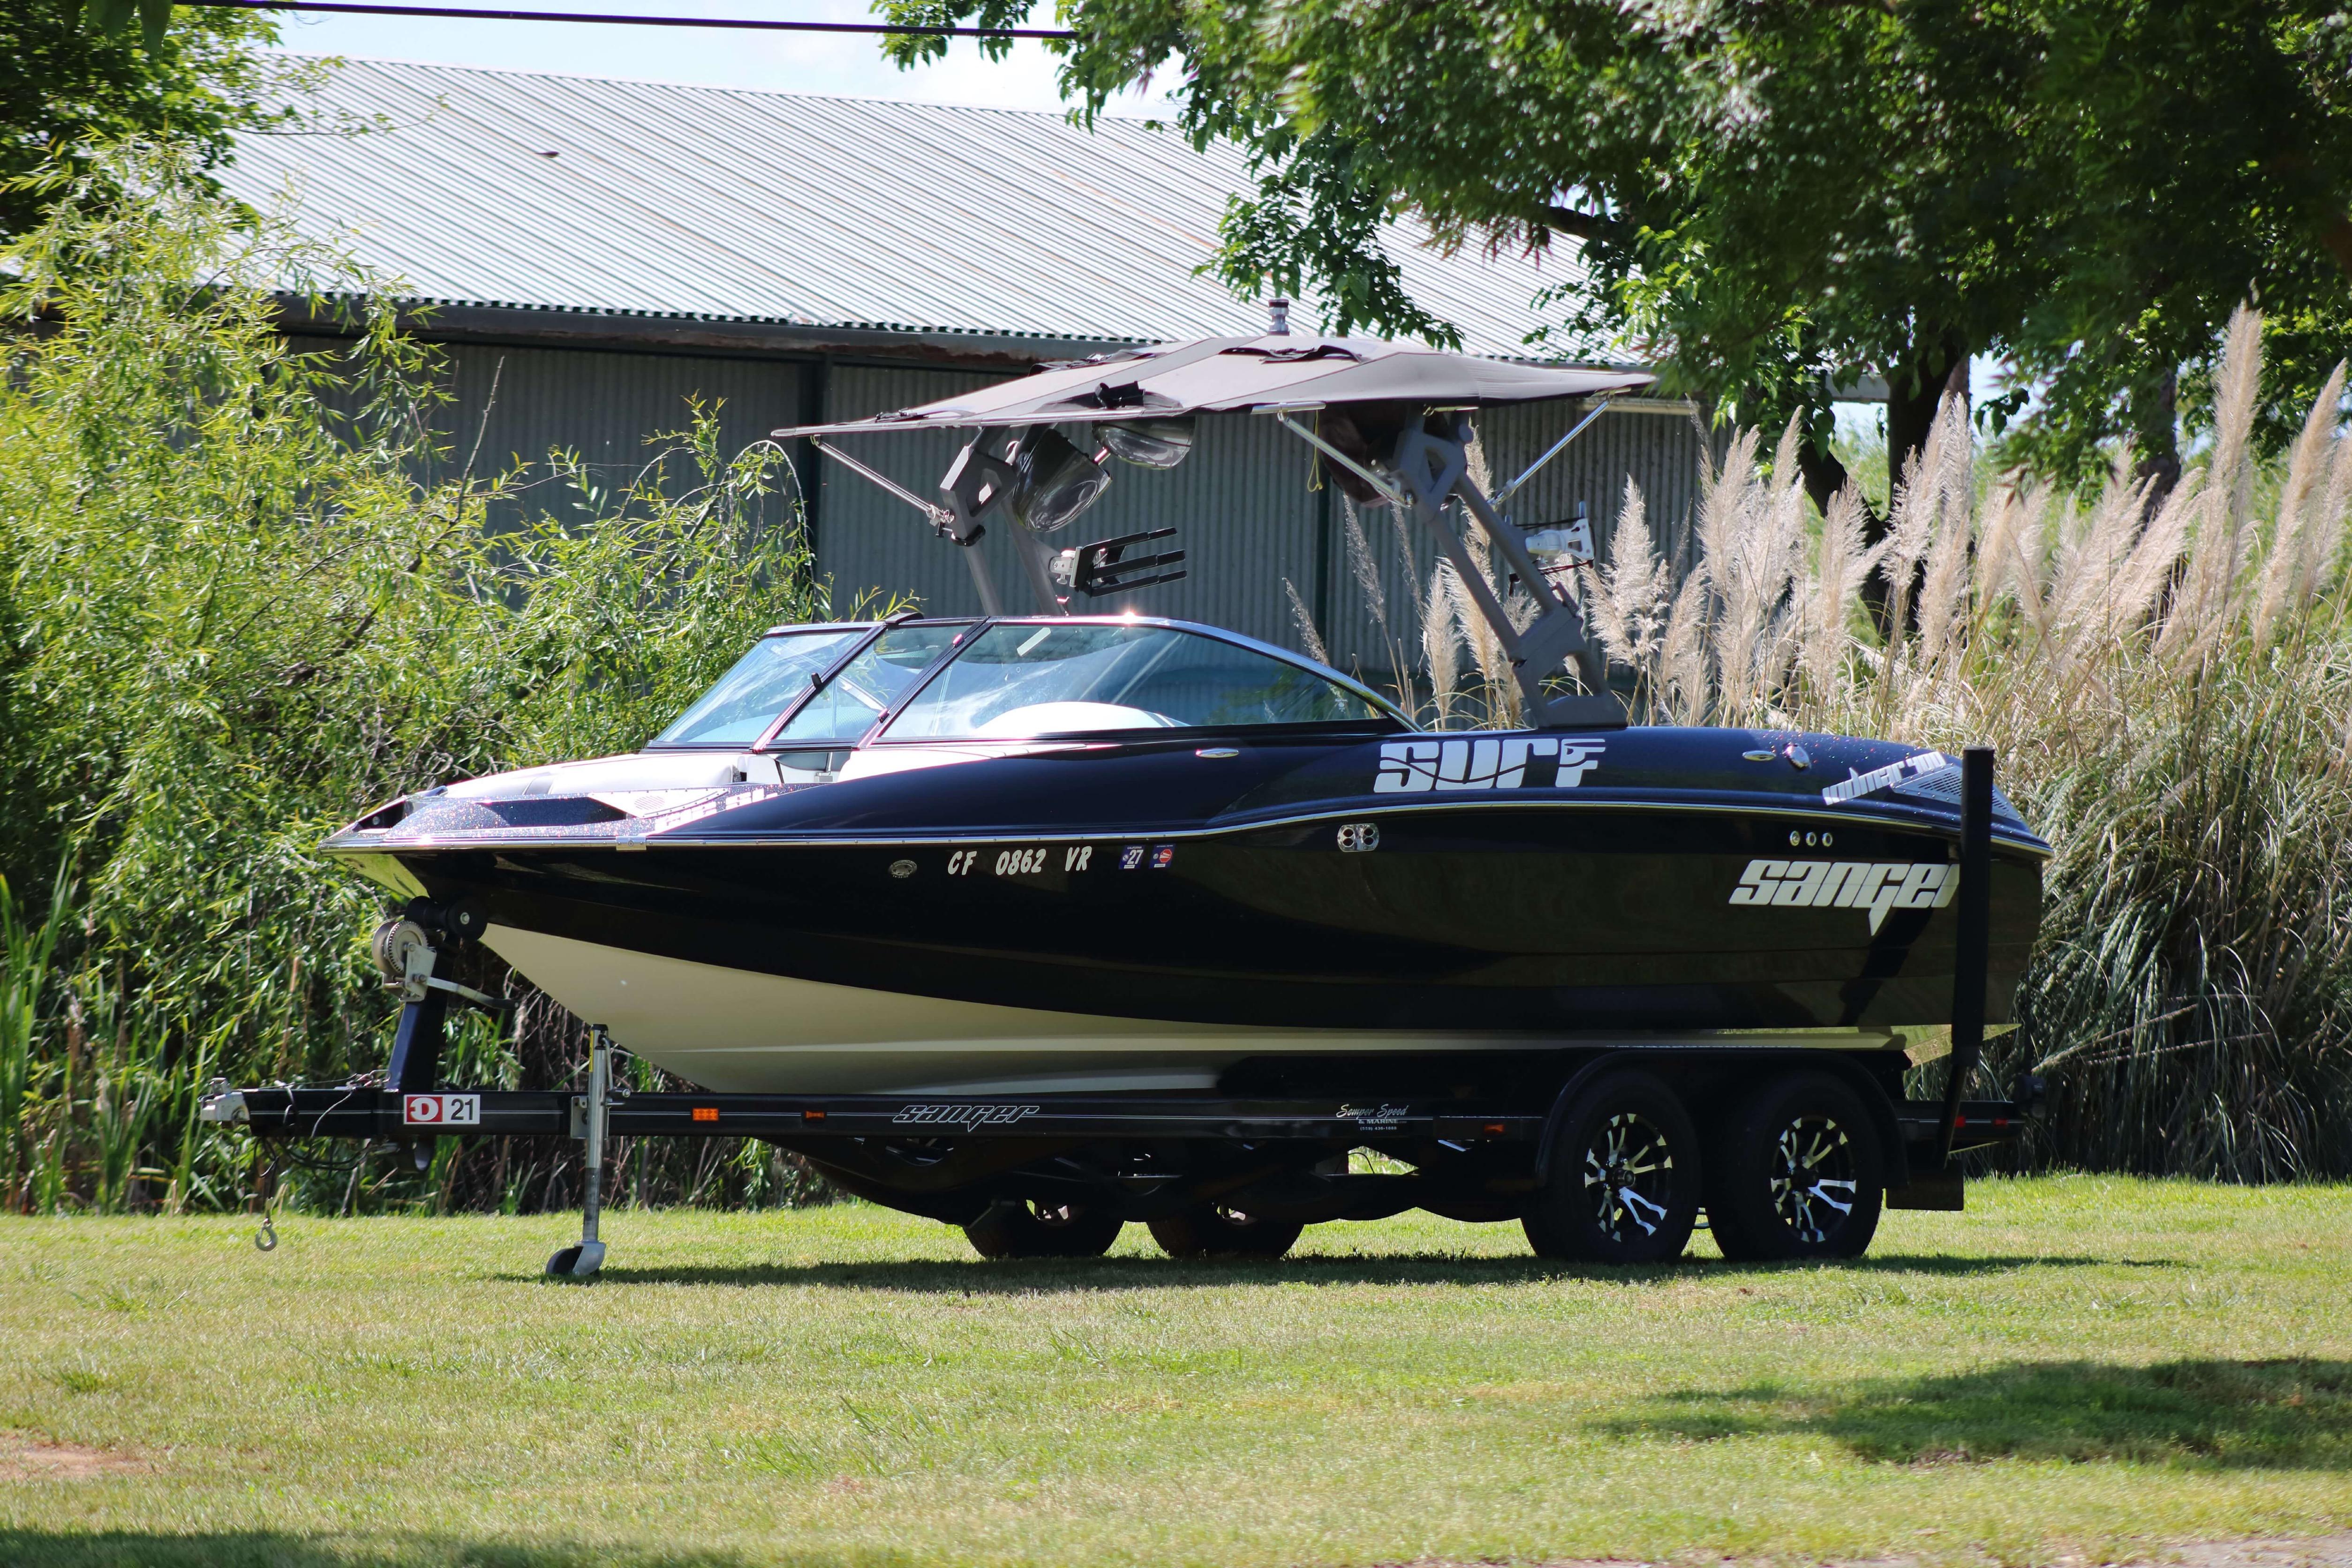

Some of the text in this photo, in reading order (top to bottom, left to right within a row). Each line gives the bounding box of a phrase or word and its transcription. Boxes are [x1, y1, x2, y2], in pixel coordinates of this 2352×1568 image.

[948, 846, 1092, 875] CF 0862 VR
[1127, 849, 1144, 865] 27
[451, 1098, 474, 1121] 21
[1336, 1103, 1409, 1120] Semper Speed
